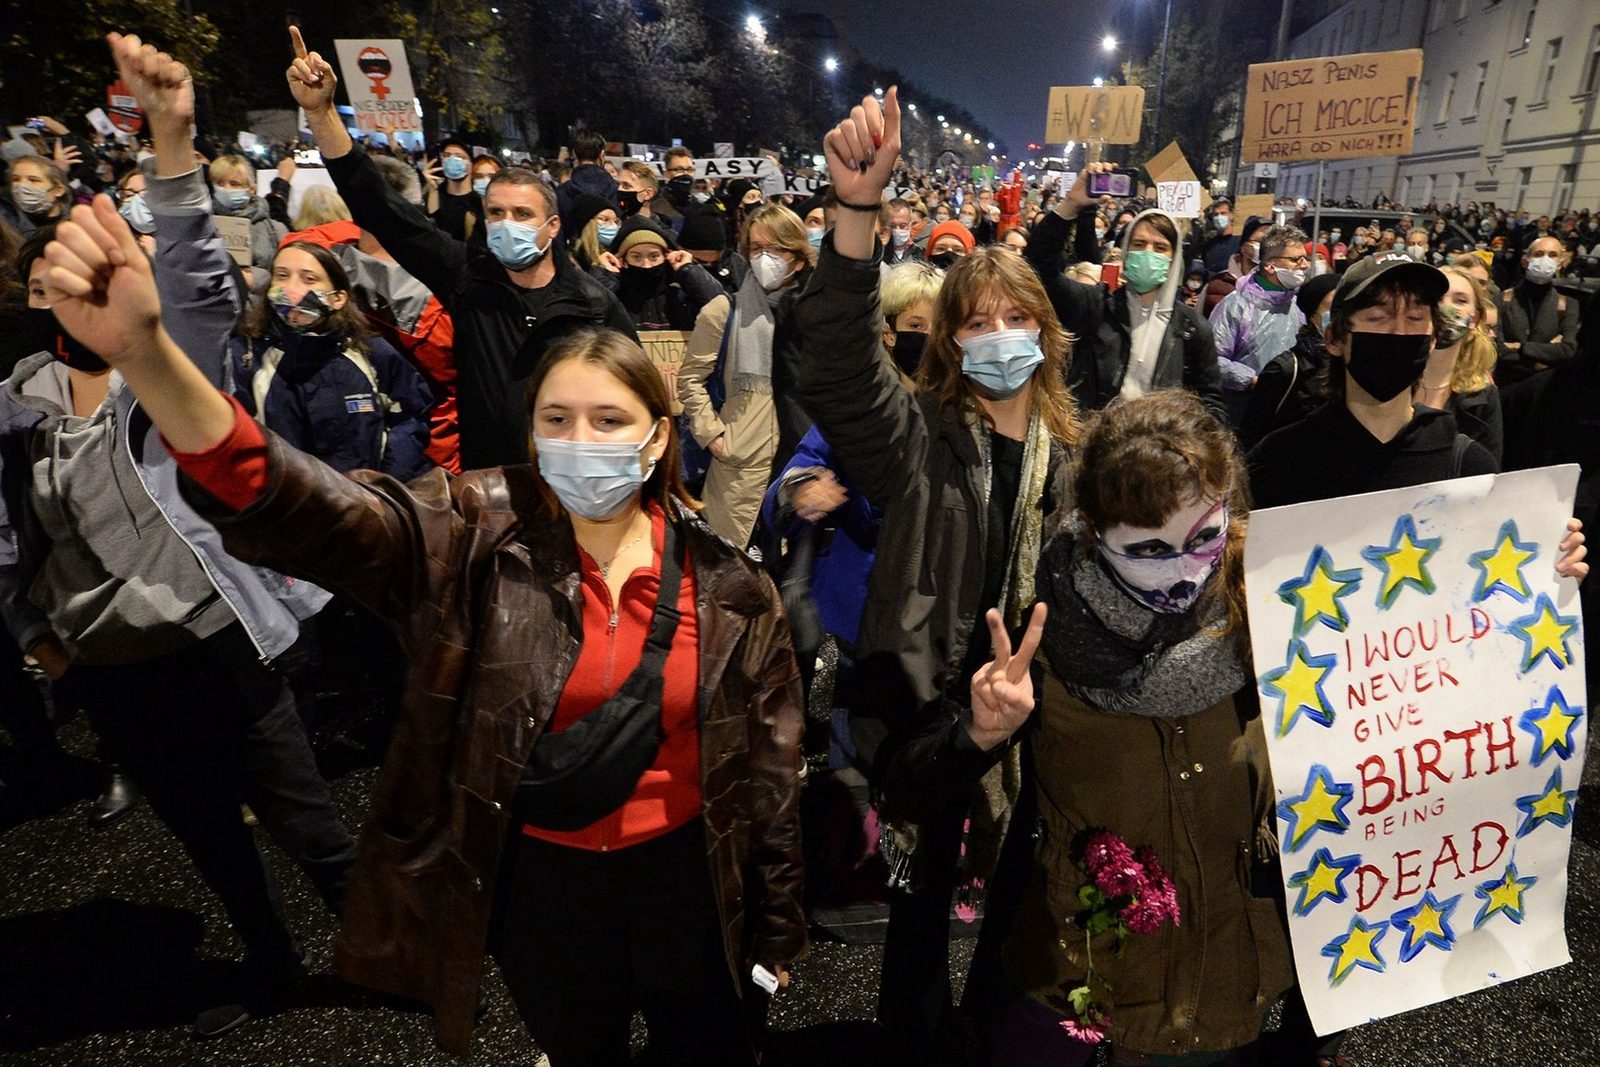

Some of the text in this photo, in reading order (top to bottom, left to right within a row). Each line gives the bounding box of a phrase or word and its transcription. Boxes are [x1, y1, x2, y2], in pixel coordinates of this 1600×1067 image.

[1262, 61, 1378, 92] NASZ PENIS
[1261, 101, 1304, 139] ICH
[1258, 141, 1303, 159] WARA
[1311, 142, 1331, 153] OD
[1346, 607, 1492, 672] I WOULD
[1348, 660, 1459, 710] NEVER
[1355, 705, 1423, 743] GIVE
[1357, 716, 1520, 816] BIRTH
[1365, 798, 1445, 841] BEING
[1355, 821, 1509, 911] DEAD
